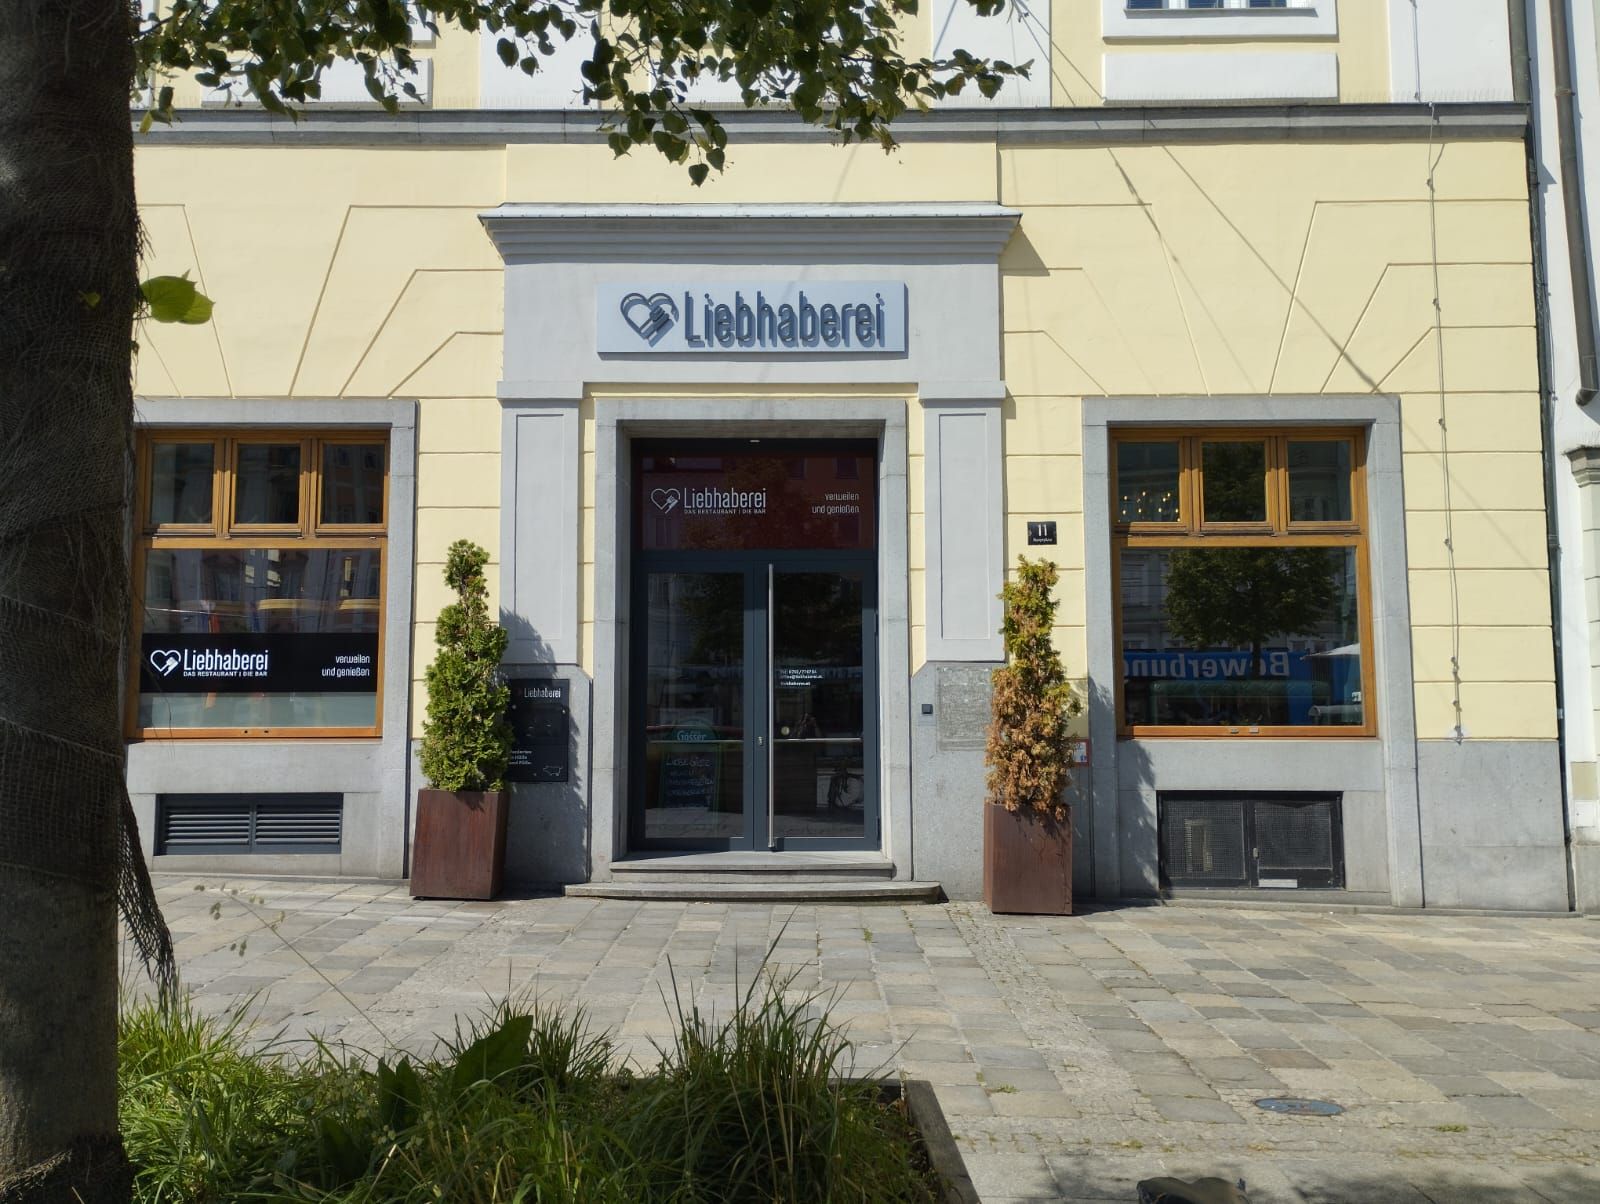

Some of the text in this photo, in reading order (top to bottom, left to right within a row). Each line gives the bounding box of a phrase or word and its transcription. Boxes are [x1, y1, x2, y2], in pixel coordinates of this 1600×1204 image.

[684, 290, 883, 345] Liebhaberei
[684, 487, 766, 508] Liebhaberei
[825, 491, 860, 501] verweilen
[811, 504, 826, 514] und
[1038, 523, 1048, 537] 11
[183, 648, 269, 670] Liebhaberei
[335, 653, 371, 664] verweilen
[321, 666, 370, 678] und genießen
[524, 687, 561, 698] Liebhaberei
